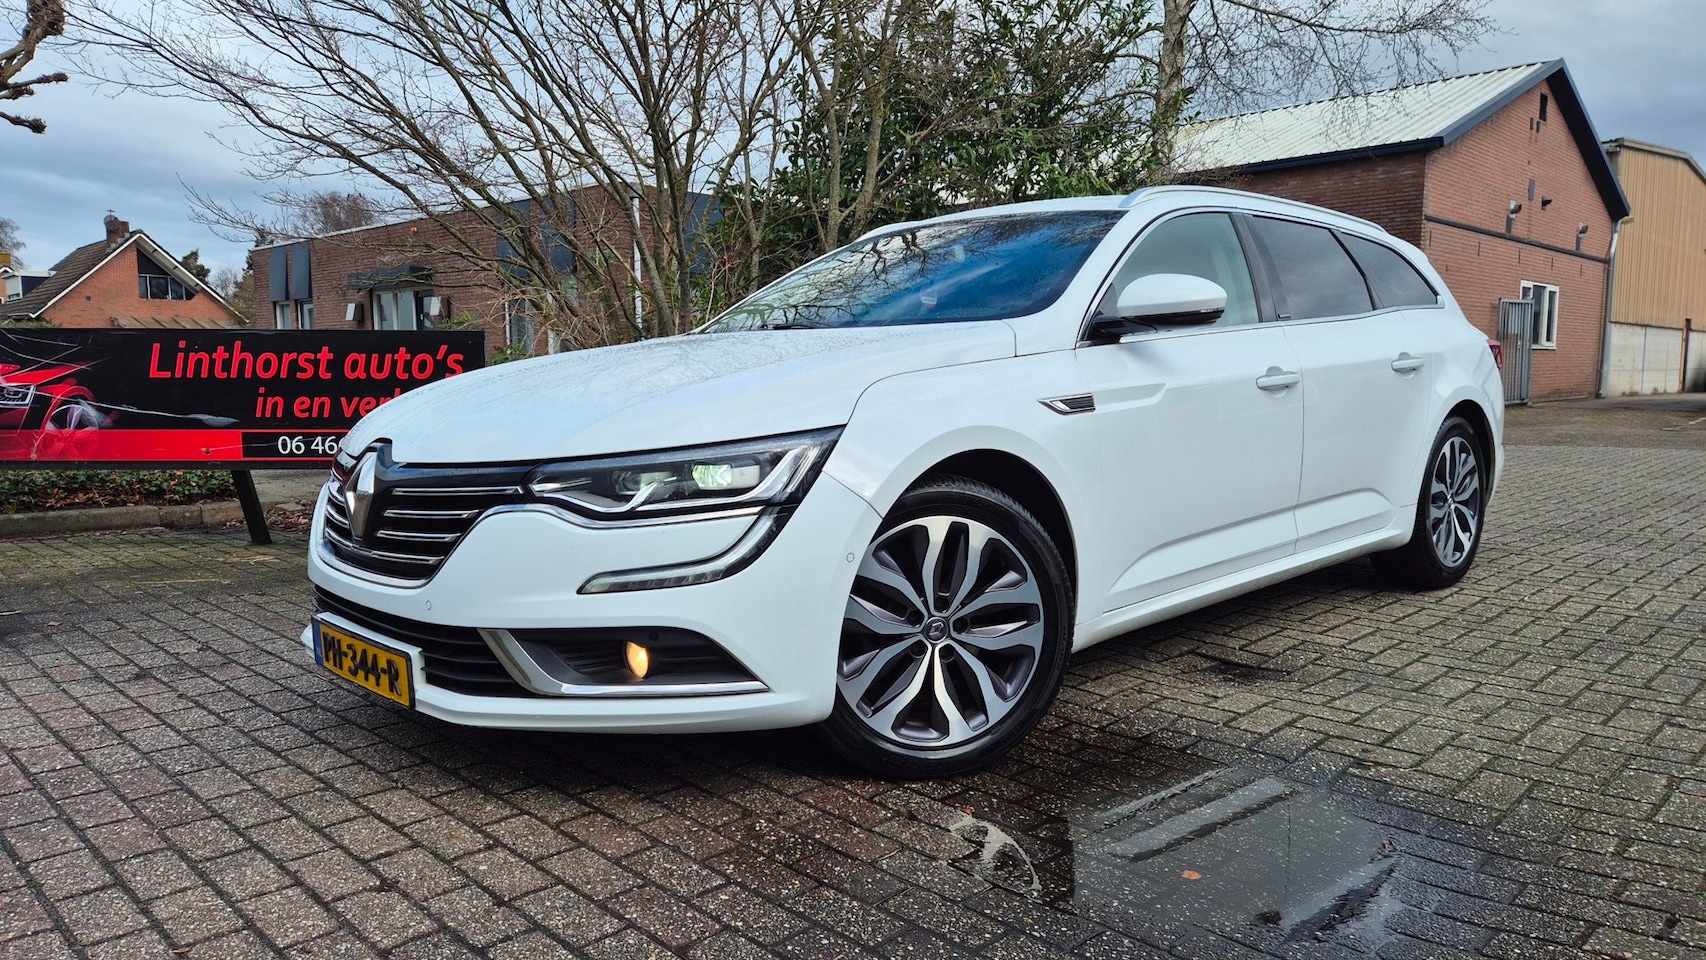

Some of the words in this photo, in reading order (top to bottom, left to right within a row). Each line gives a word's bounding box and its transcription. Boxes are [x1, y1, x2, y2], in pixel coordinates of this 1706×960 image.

[149, 340, 334, 380] Linthorst
[344, 344, 465, 380] auto’s
[255, 386, 284, 419] in
[293, 395, 331, 419] en
[340, 387, 402, 419] ve
[277, 435, 306, 456] 06
[310, 435, 338, 456] 46
[322, 631, 402, 696] PH-344-R
